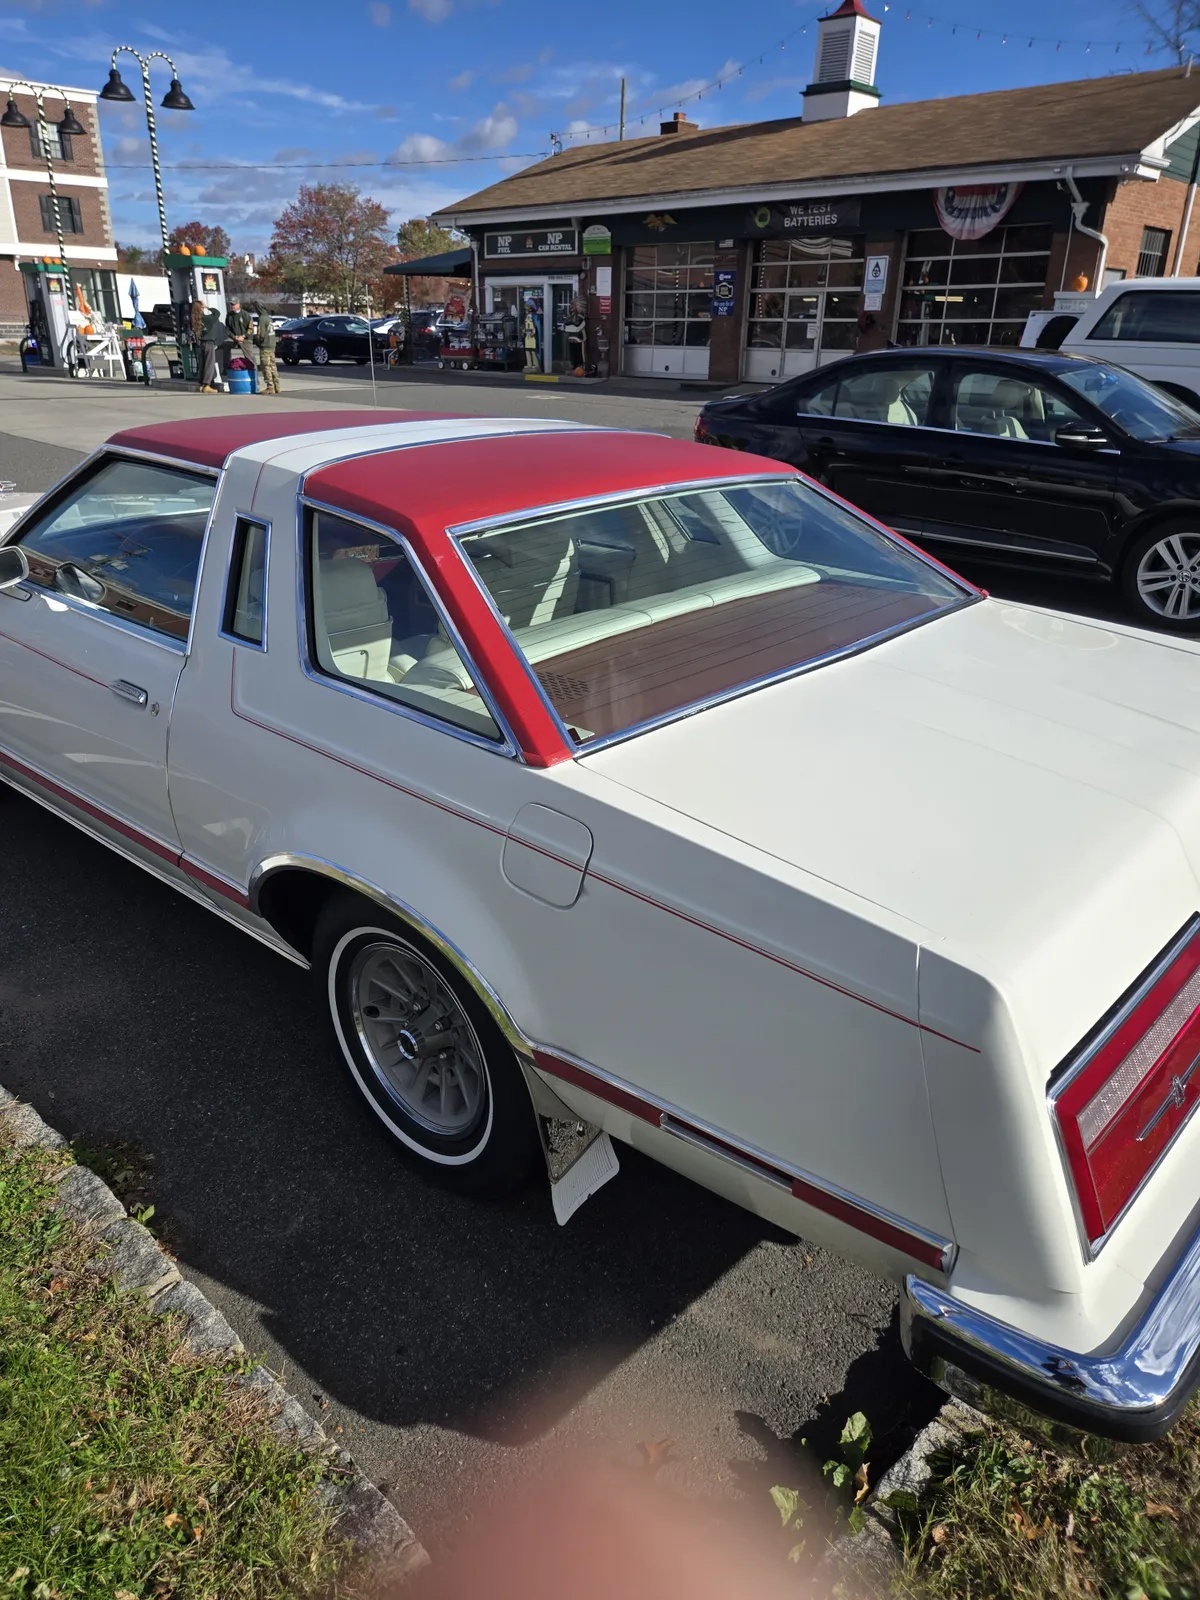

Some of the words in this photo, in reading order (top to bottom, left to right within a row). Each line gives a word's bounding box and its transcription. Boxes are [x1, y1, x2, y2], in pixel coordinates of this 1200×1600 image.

[790, 206, 804, 214] WE
[808, 204, 832, 214] TEST
[784, 214, 838, 227] BATTERIES
[498, 236, 512, 247] NP
[547, 233, 563, 244] NP
